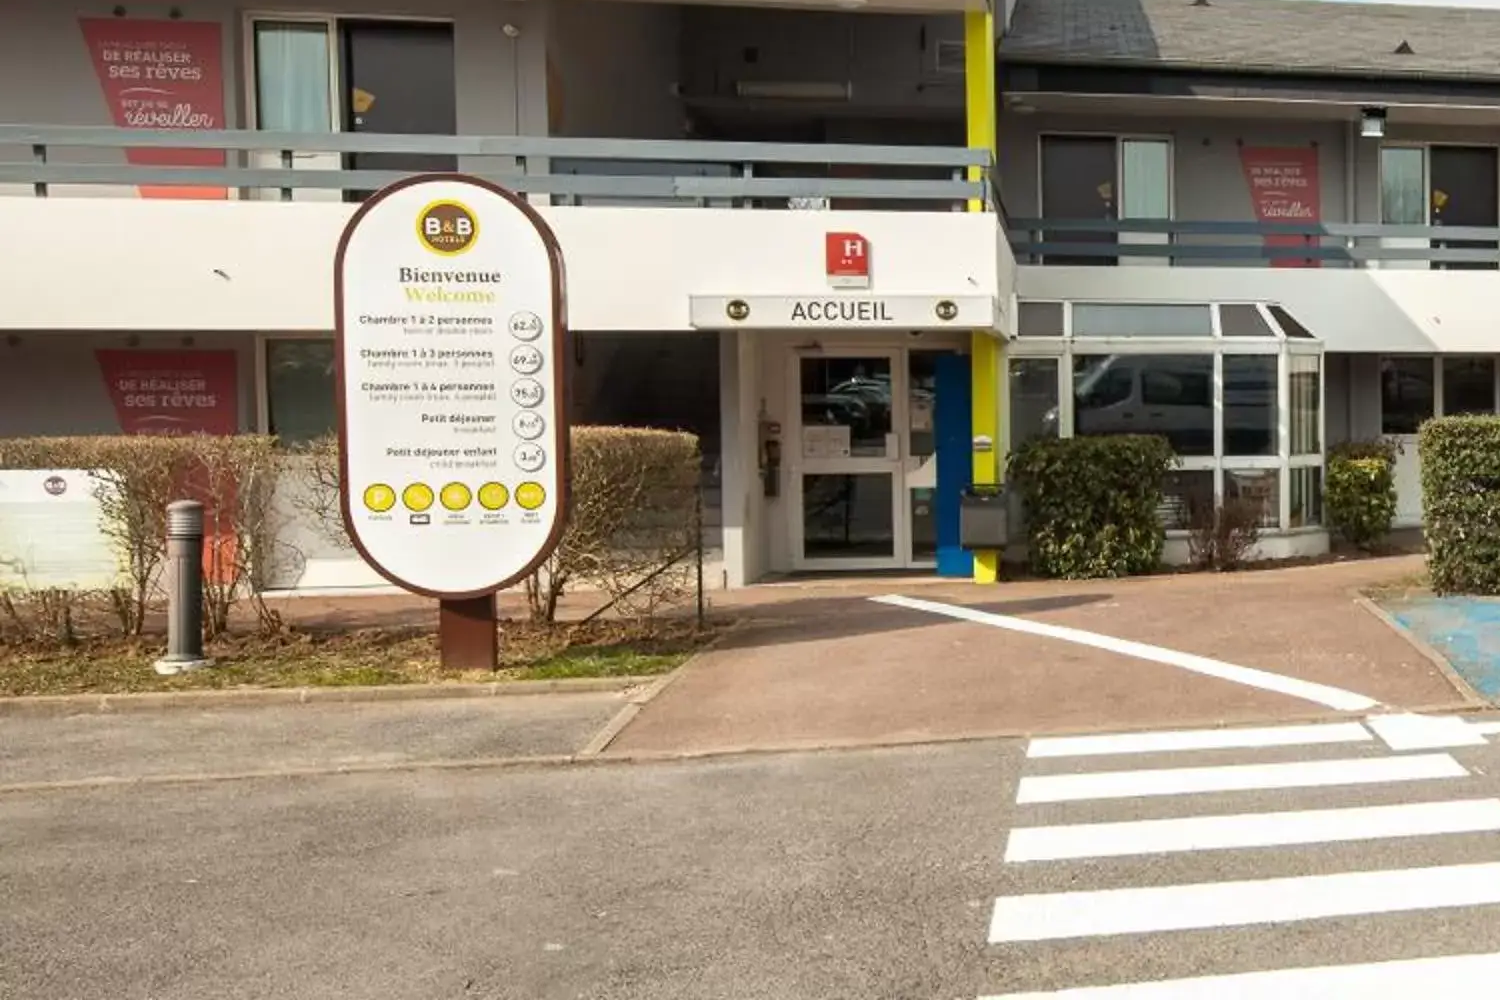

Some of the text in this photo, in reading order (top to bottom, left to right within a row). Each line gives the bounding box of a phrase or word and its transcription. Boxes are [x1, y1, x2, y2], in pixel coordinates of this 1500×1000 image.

[103, 50, 121, 62] DE
[108, 63, 203, 81] ses rêves
[425, 217, 473, 235] B&B
[844, 239, 864, 257] H
[399, 266, 502, 284] Bienvenue
[404, 287, 497, 304] Welcome
[791, 301, 894, 321] ACCUEIL
[359, 314, 408, 325] Chambre
[428, 315, 435, 325] 2
[437, 316, 494, 326] personnes
[360, 348, 409, 359] Chambre
[437, 350, 494, 360] personnes
[361, 382, 411, 392] Chambre
[439, 382, 496, 393] personnes
[421, 413, 447, 423] Petit
[386, 447, 412, 457] Petit
